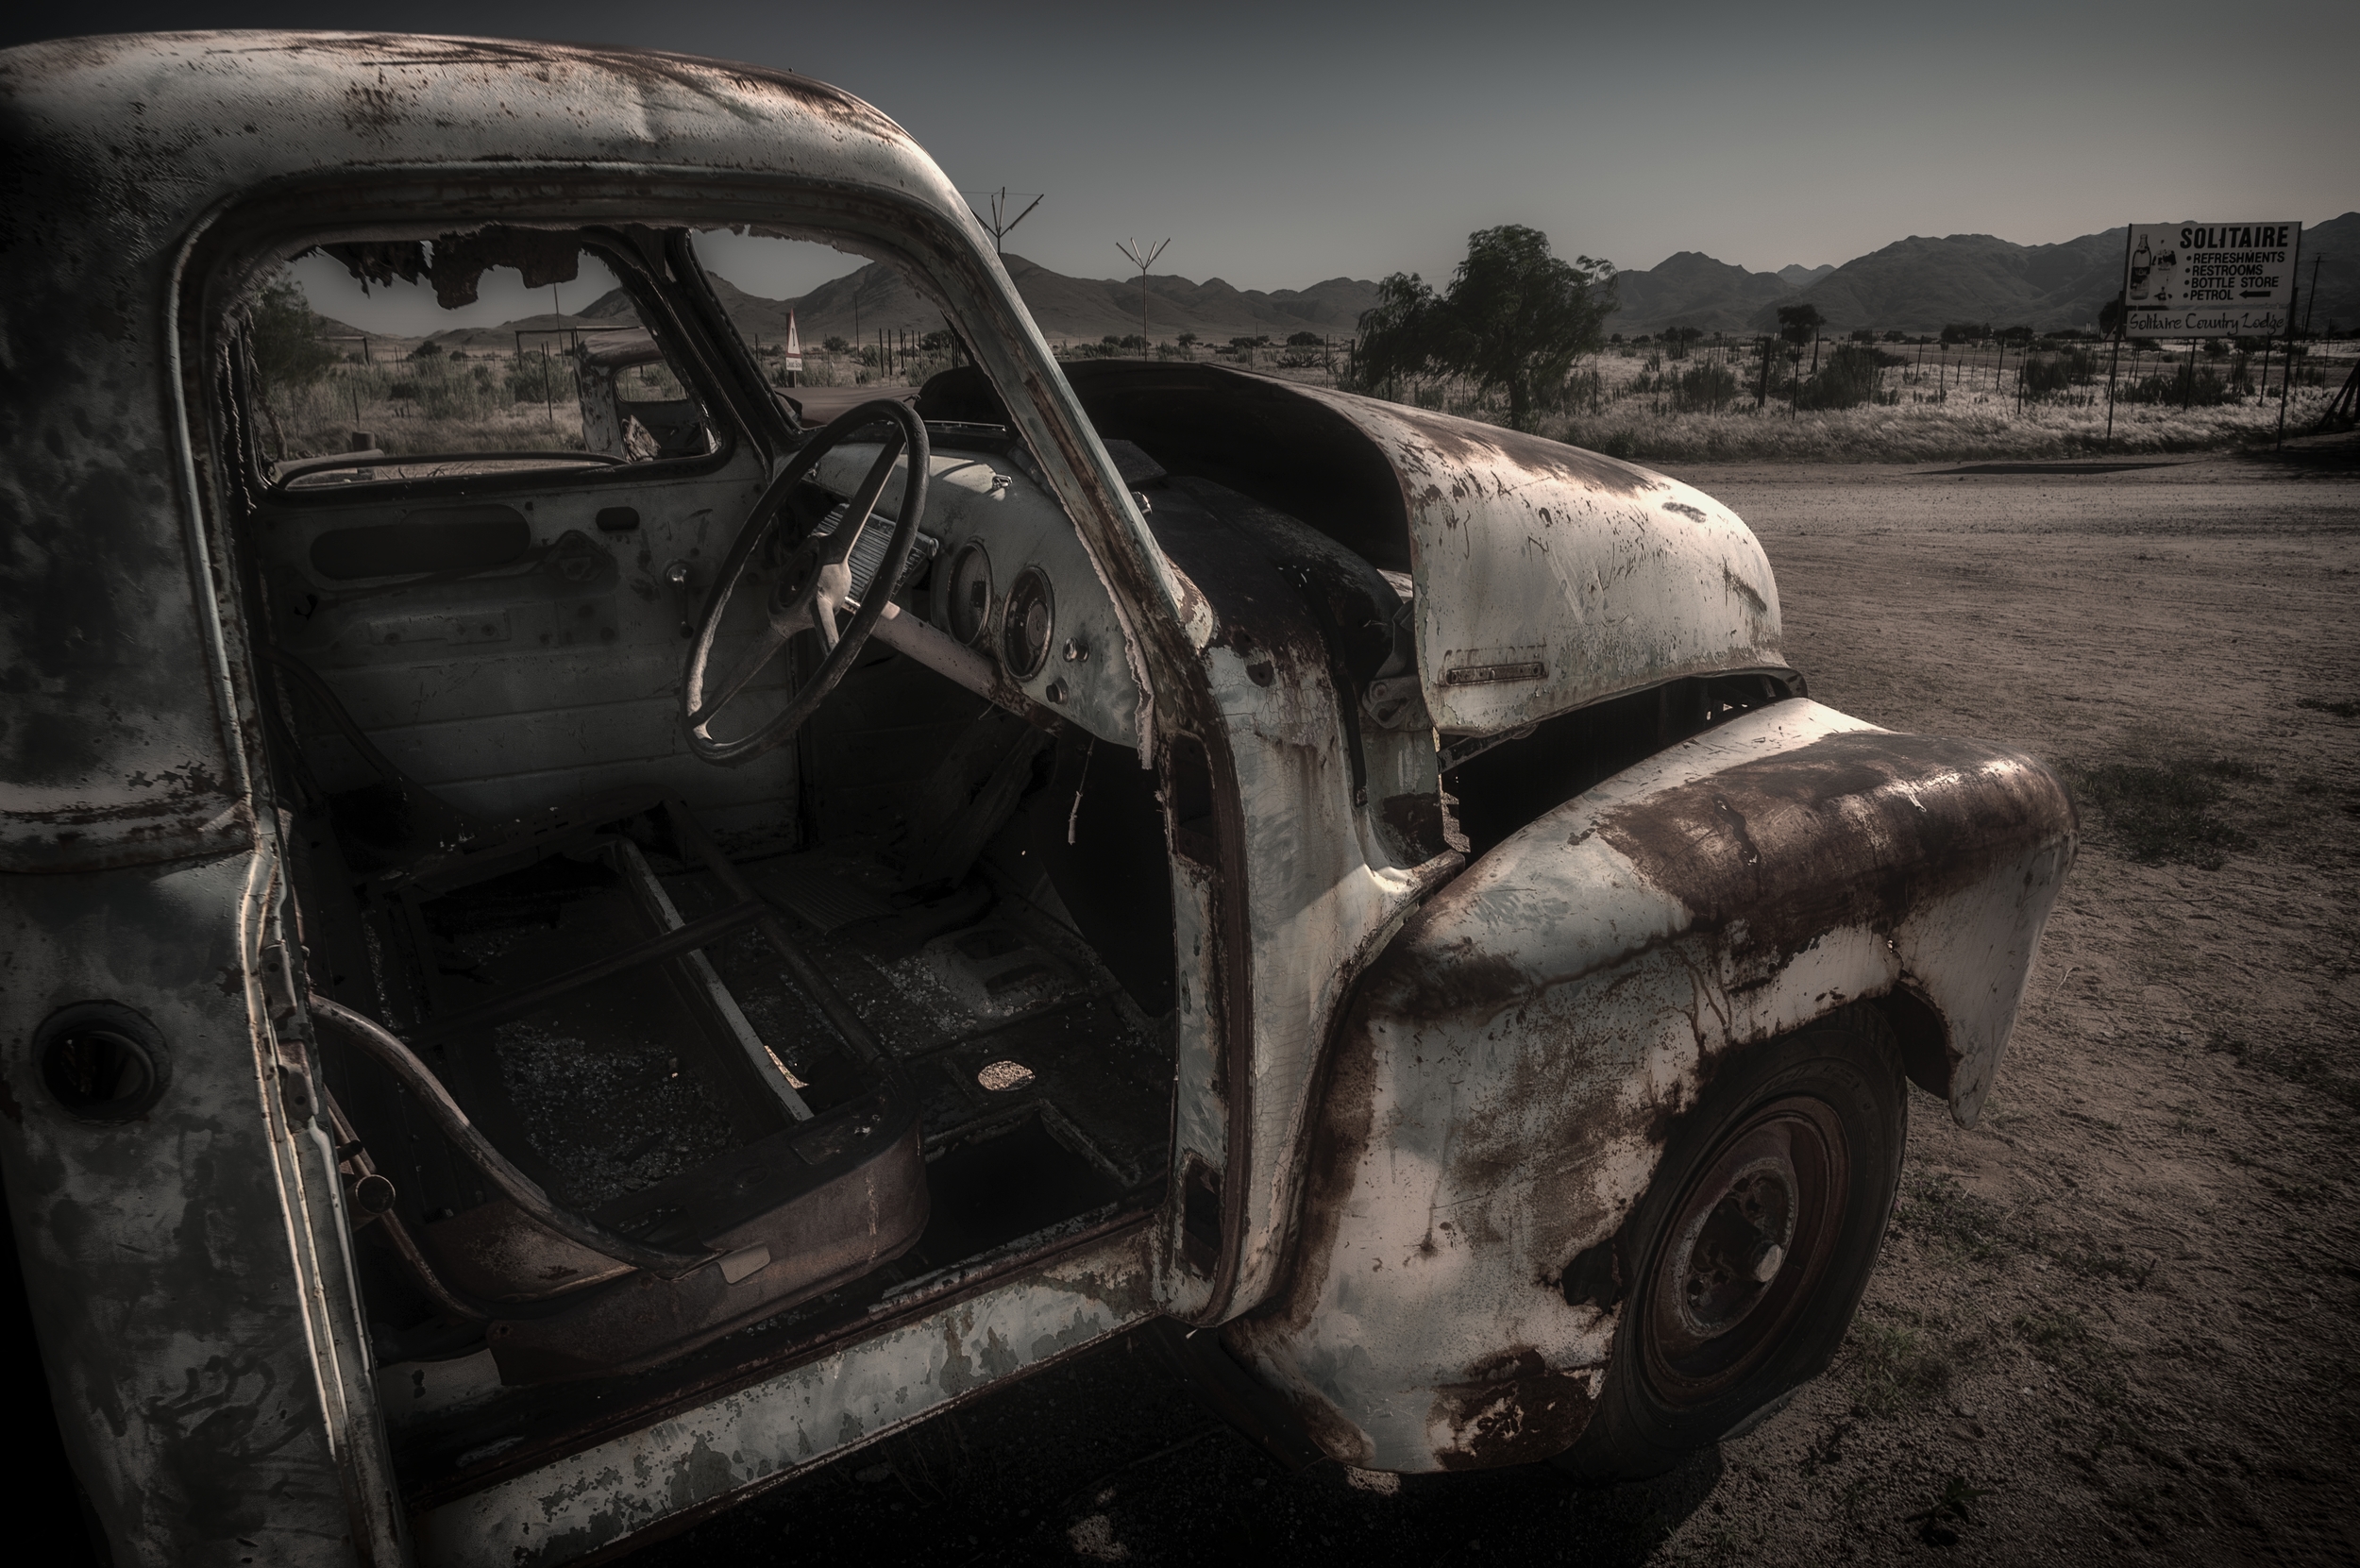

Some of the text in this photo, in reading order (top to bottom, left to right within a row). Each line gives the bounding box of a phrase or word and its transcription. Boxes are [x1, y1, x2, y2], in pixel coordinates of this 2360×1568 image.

[2180, 226, 2288, 248] SOLITAIRE
[2193, 251, 2284, 263] REFRESHMENTS
[2192, 264, 2263, 276] RESTROOMS
[2191, 276, 2279, 288] BOTTLE STORE
[2190, 289, 2234, 300] PETROL
[2130, 312, 2284, 335] Solitaire Country Lodge
